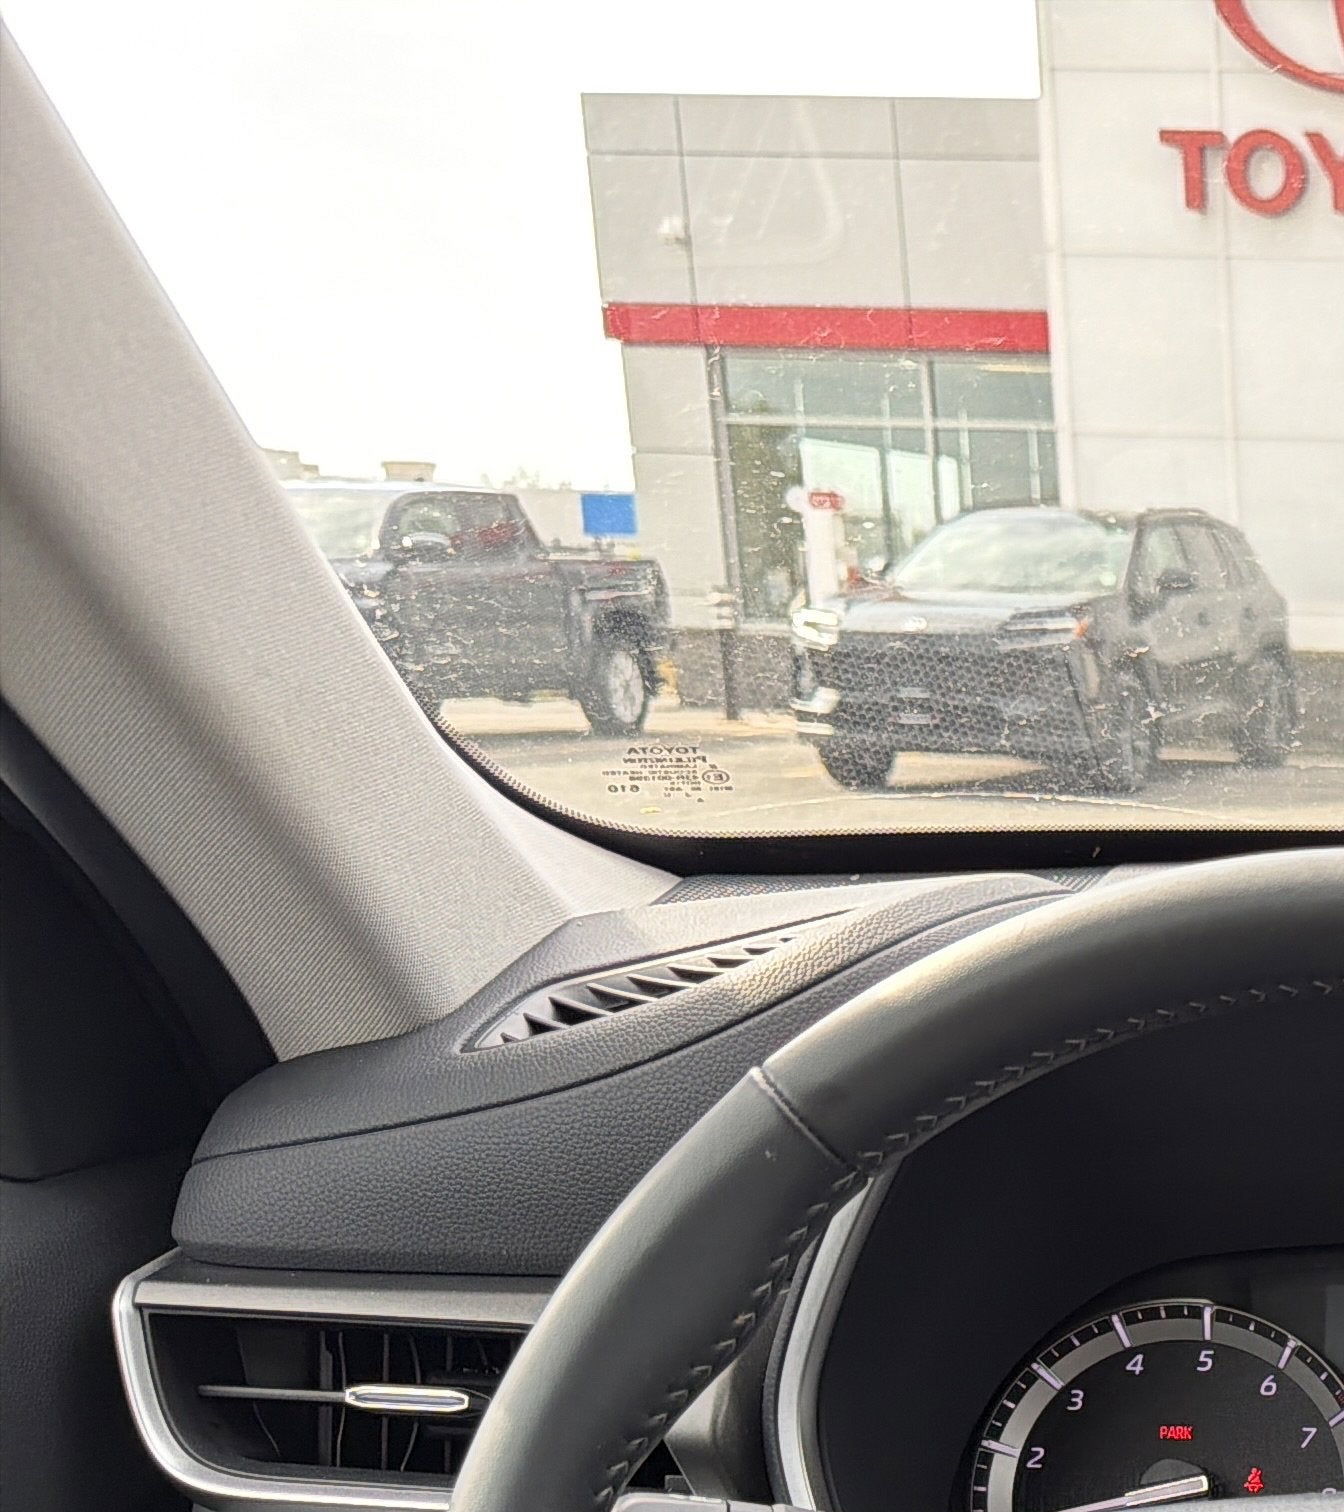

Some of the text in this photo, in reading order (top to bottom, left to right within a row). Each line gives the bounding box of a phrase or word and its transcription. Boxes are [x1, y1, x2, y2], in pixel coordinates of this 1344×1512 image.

[1125, 1354, 1144, 1375] 4
[1197, 1350, 1214, 1372] 5
[1260, 1375, 1277, 1396] 6
[1067, 1389, 1084, 1411] 3
[1159, 1425, 1194, 1441] PARK
[1301, 1427, 1318, 1449] 7
[1026, 1447, 1045, 1469] 2
